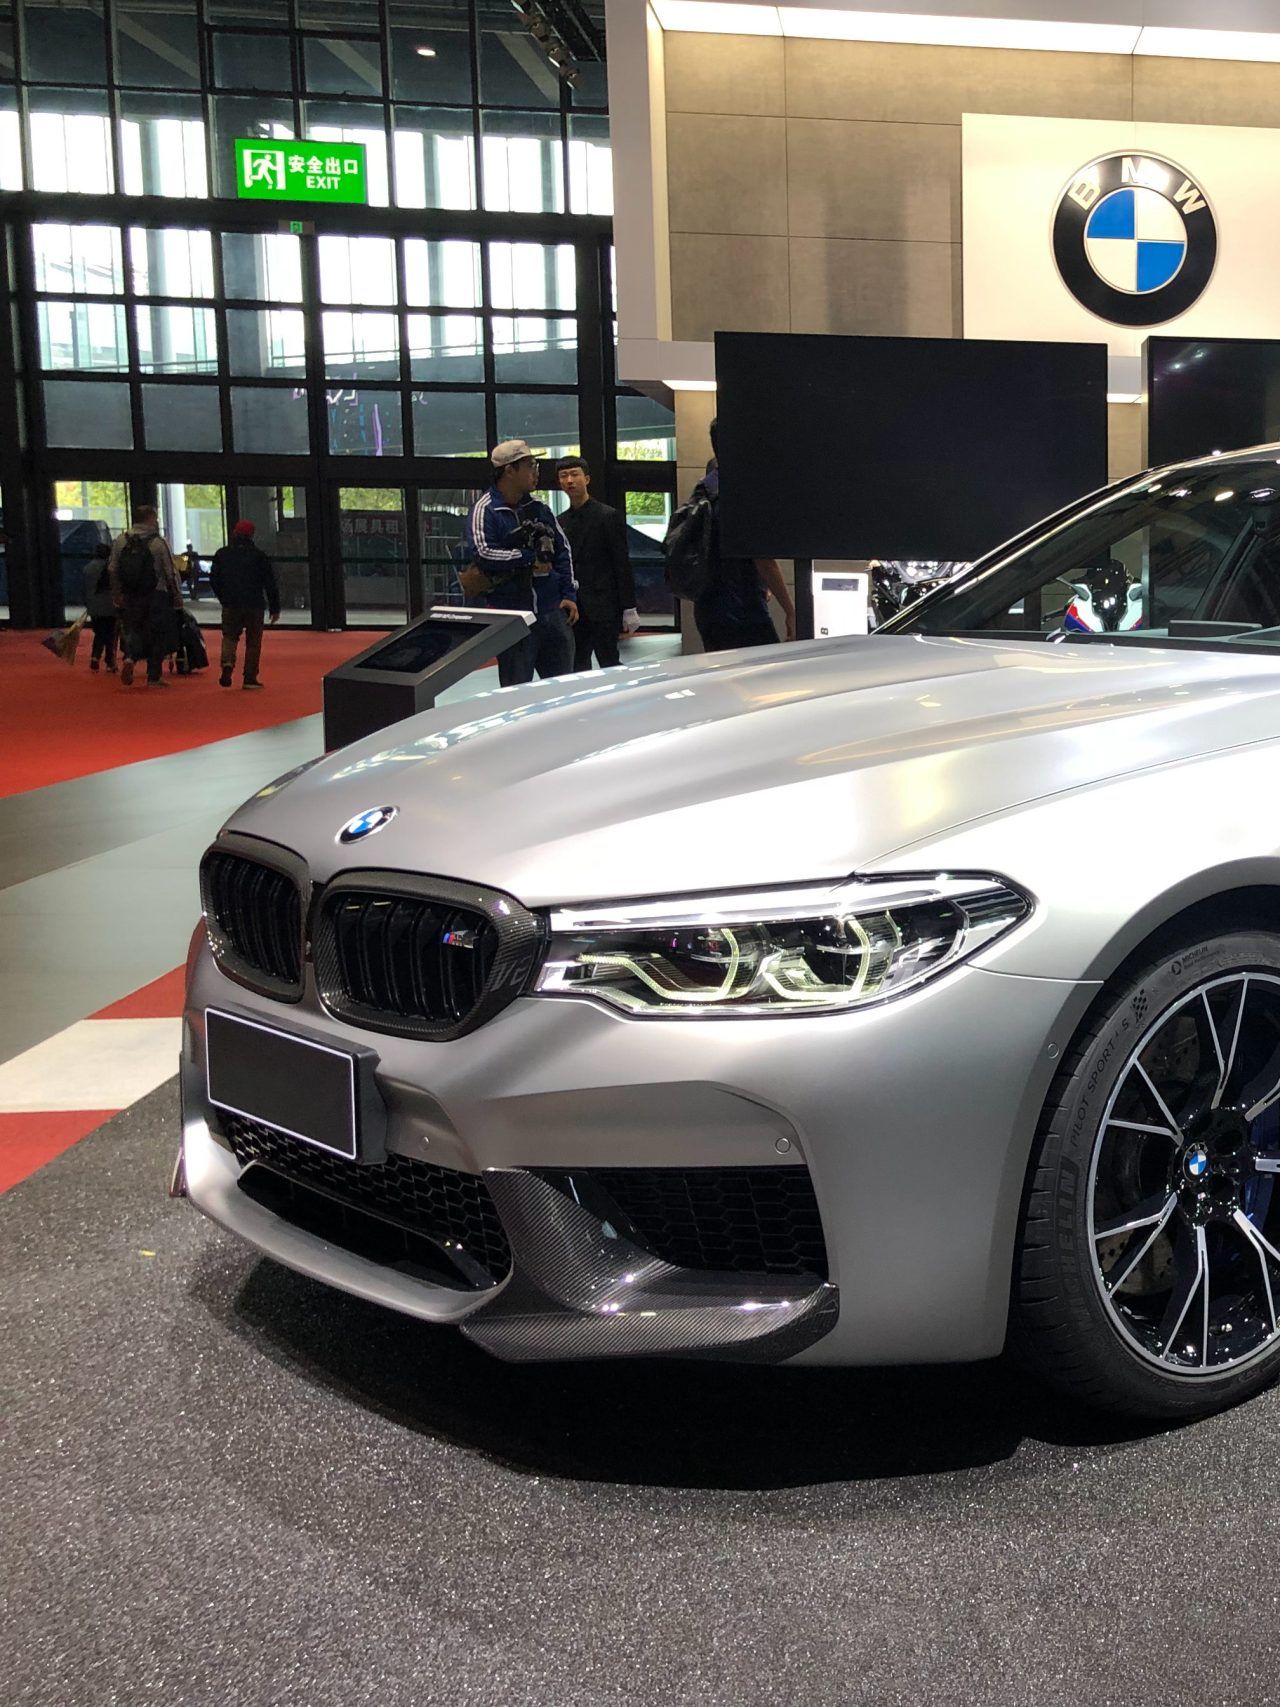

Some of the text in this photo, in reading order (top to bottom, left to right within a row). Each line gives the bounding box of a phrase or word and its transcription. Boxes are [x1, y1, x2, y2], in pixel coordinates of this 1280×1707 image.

[287, 154, 359, 175] 安全出口
[305, 175, 341, 190] EXIT
[1067, 157, 1206, 215] BMW
[1087, 1038, 1115, 1094] SPORT
